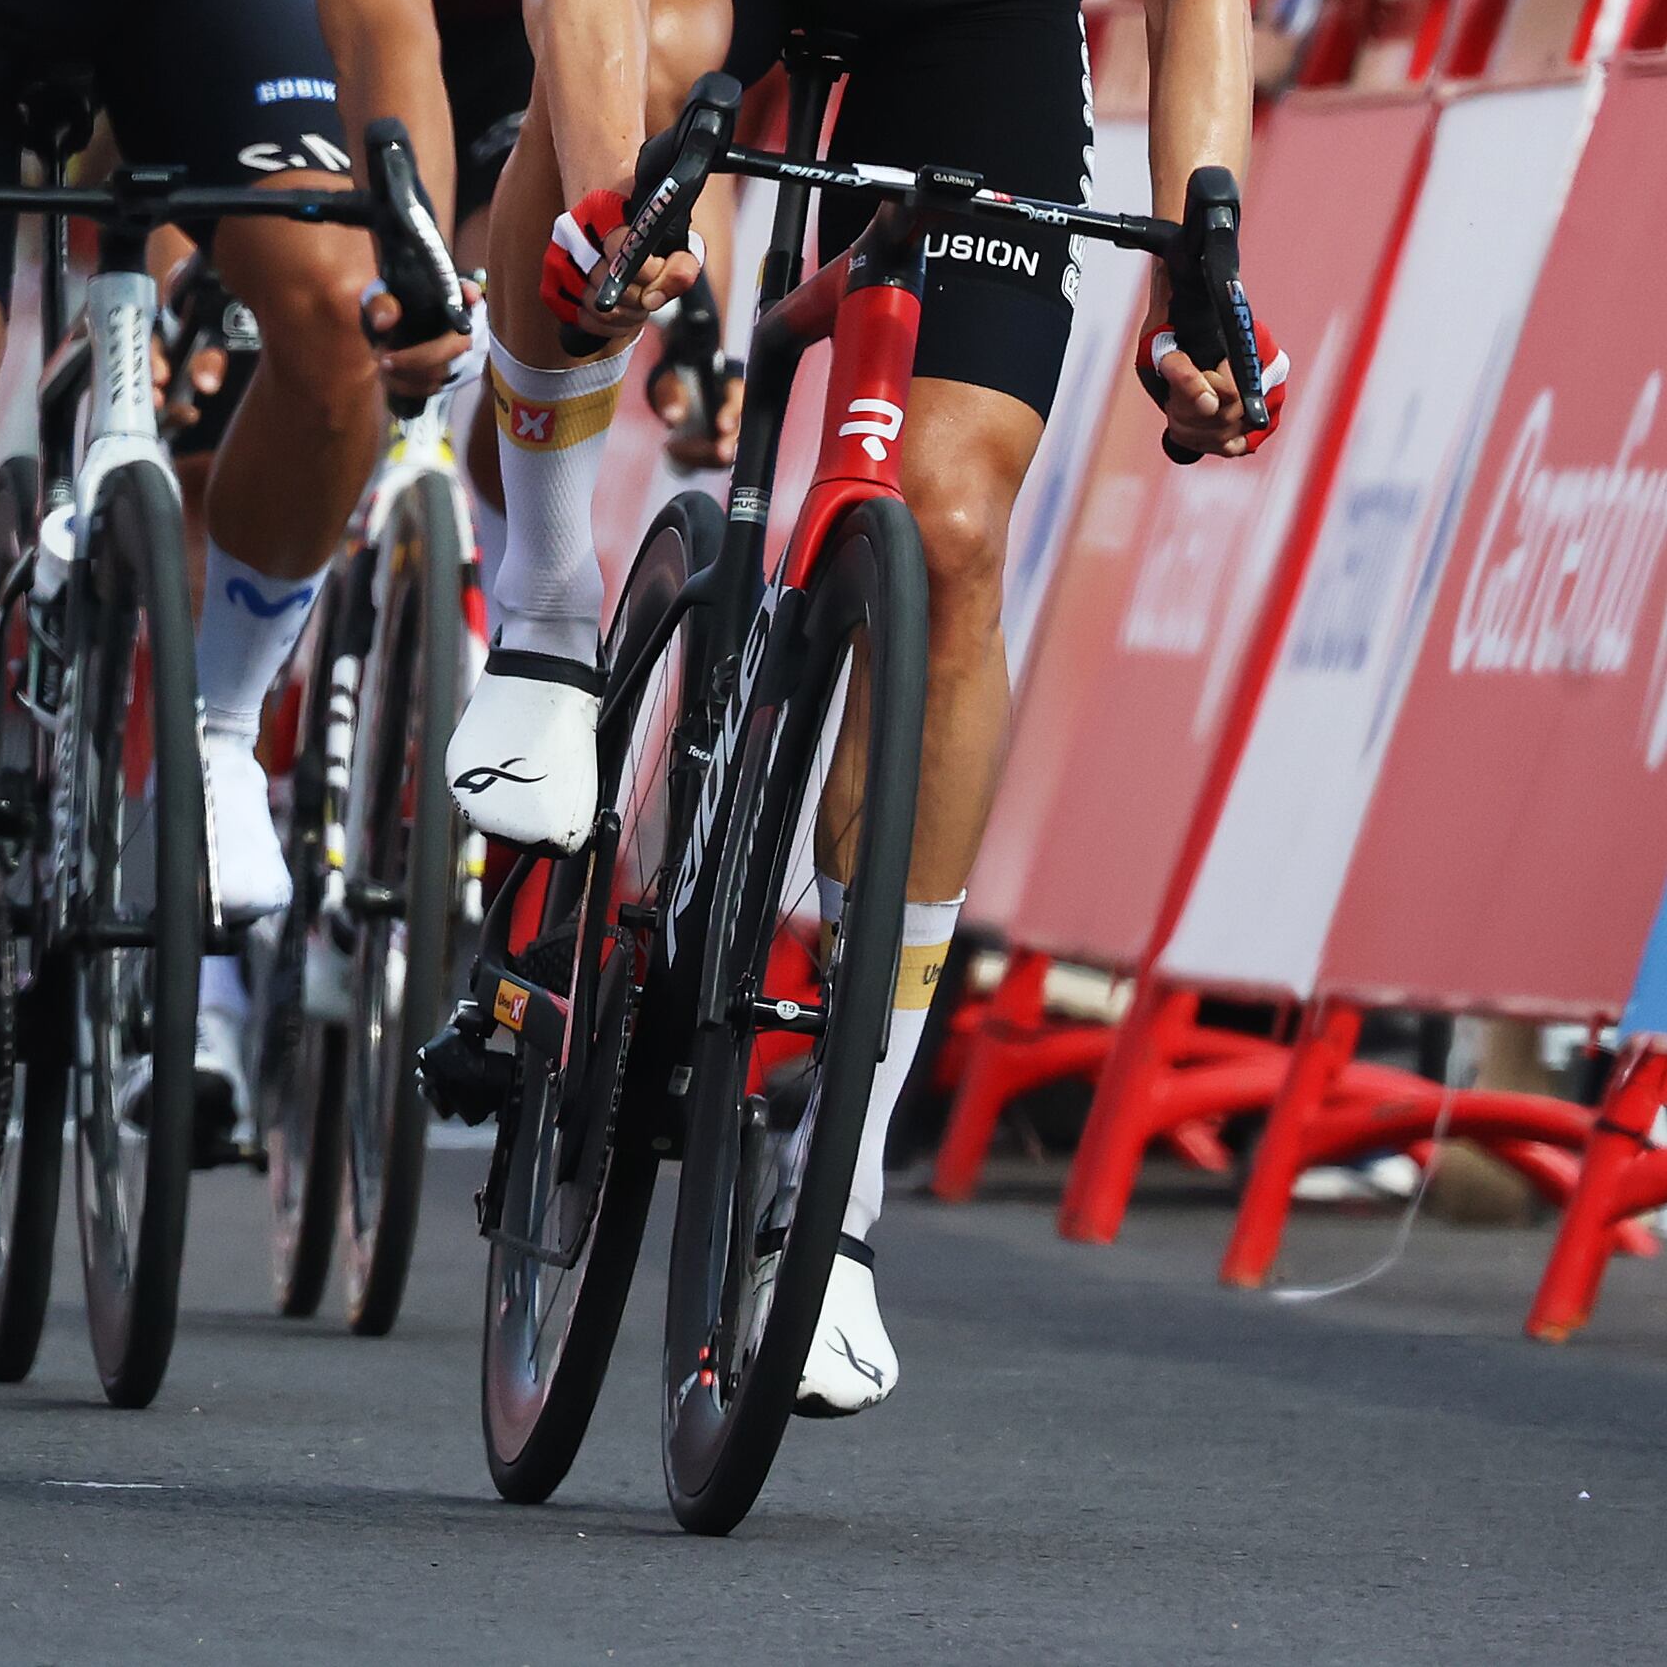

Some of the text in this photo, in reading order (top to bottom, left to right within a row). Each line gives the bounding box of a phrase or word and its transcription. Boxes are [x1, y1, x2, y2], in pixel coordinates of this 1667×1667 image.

[257, 77, 337, 105] GOBIK
[777, 162, 872, 188] RIDLEY
[933, 173, 976, 188] GARMIN
[1016, 202, 1068, 227] Deda
[782, 1003, 796, 1014] 19
